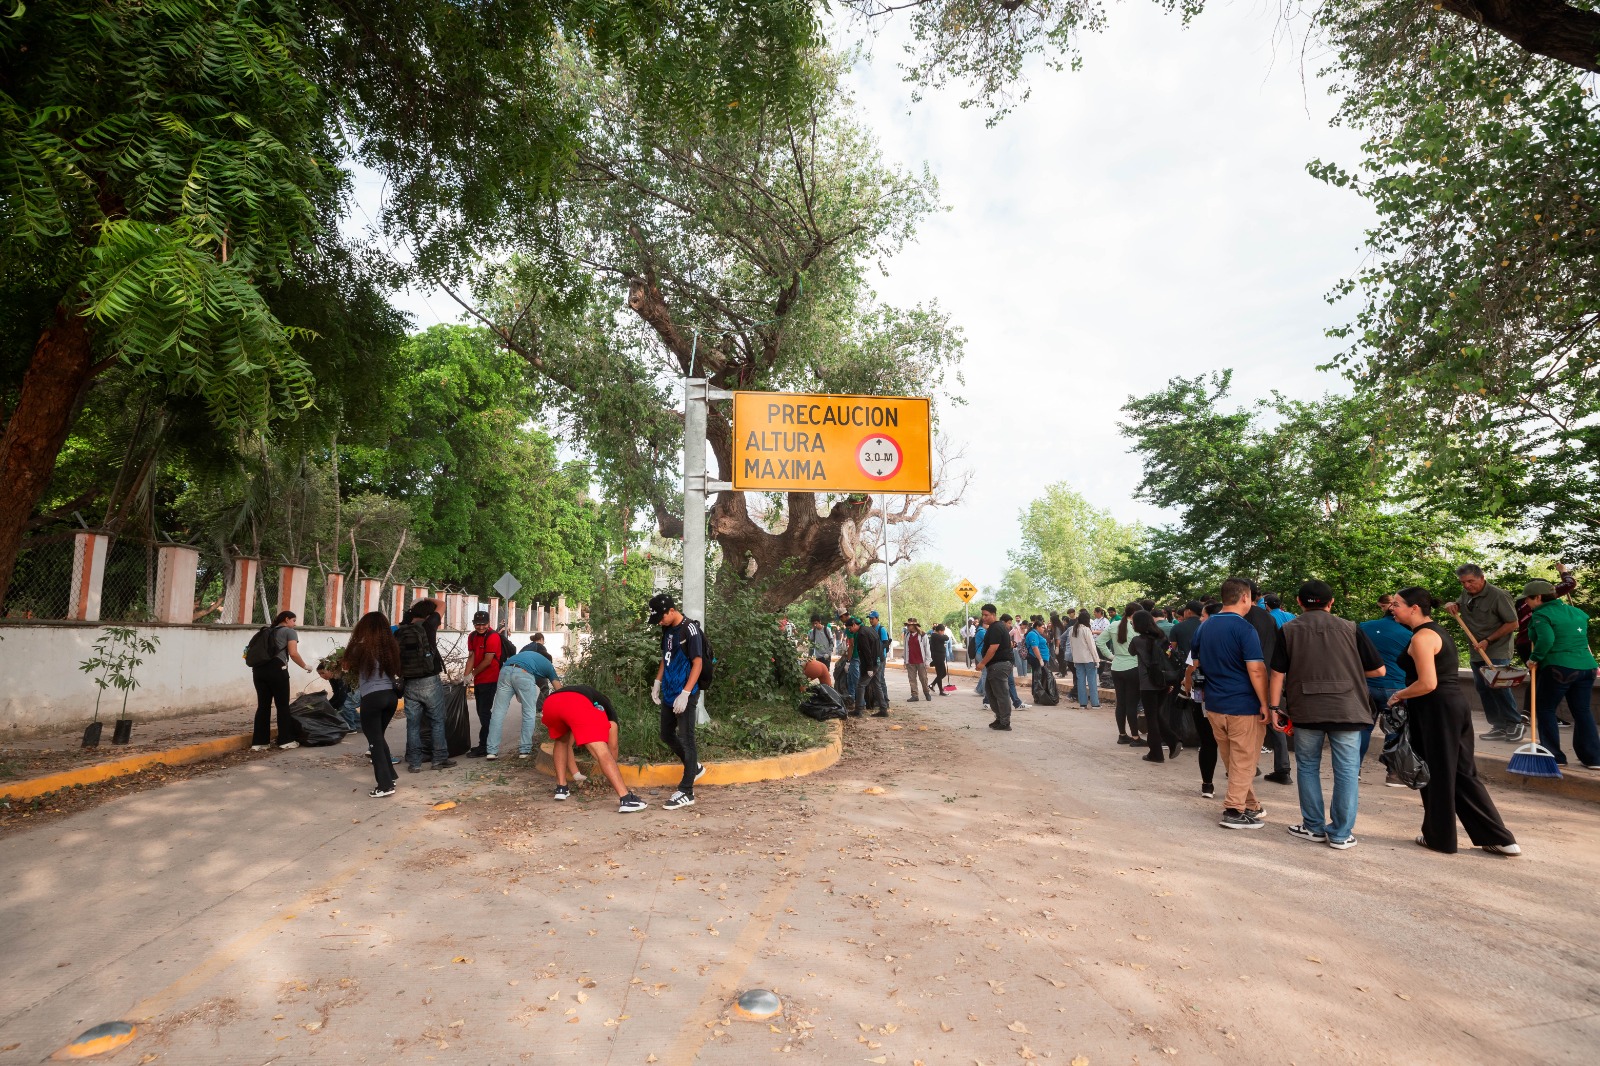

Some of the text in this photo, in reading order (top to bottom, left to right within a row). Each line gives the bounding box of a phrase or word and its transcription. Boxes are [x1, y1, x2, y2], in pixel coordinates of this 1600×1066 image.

[768, 404, 898, 427] PRECAUCION
[745, 431, 826, 453] ALTURA
[744, 458, 827, 480] MAXIMA
[664, 651, 672, 666] 9
